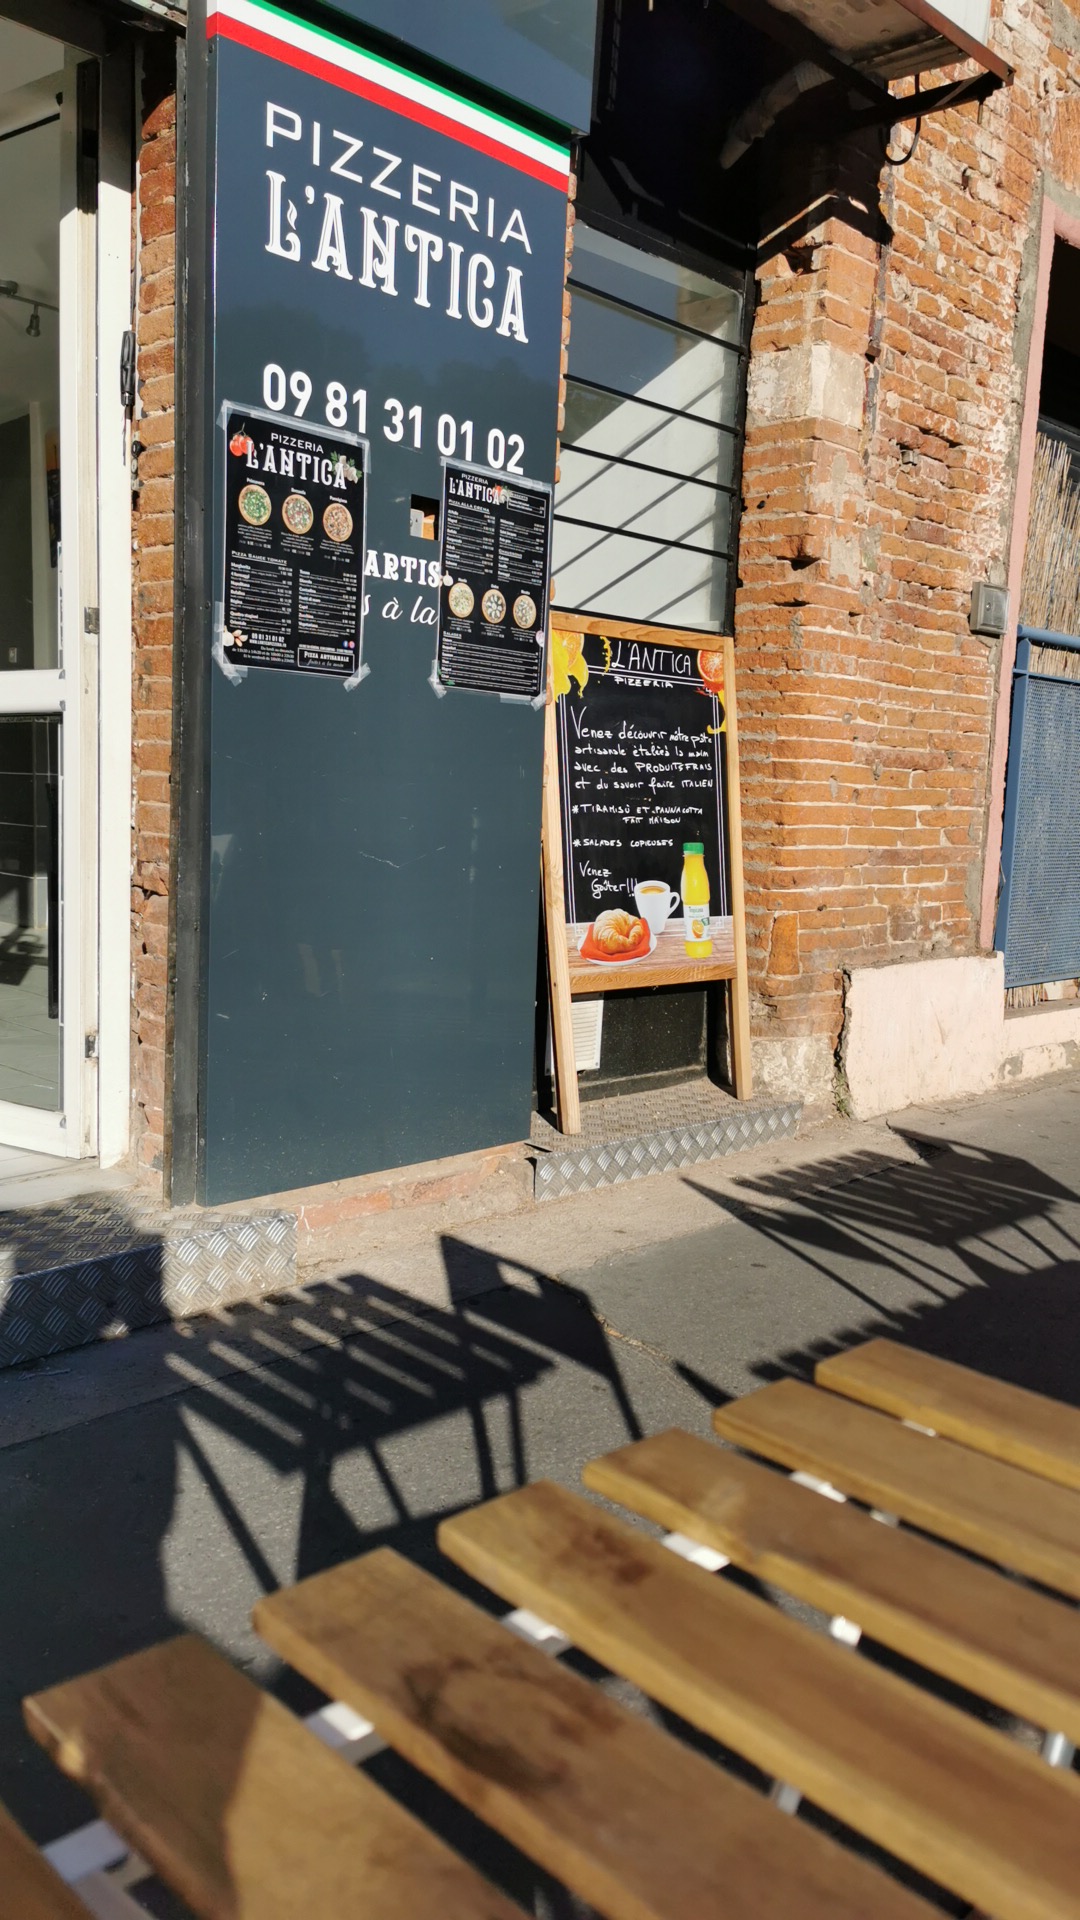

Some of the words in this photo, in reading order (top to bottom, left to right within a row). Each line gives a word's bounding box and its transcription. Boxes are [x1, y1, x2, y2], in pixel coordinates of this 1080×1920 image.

[266, 101, 532, 254] PIZZERIA
[265, 170, 529, 343] L'ANTICA
[263, 364, 312, 416] 09
[325, 382, 367, 433] 81
[383, 398, 422, 448] 31
[438, 414, 473, 461] 01
[487, 429, 525, 475] 02
[270, 432, 324, 454] PIZZERIA
[246, 440, 347, 490] L'ANTICA
[461, 473, 488, 485] PIZZERIA
[449, 477, 500, 505] L'ANTICA
[382, 597, 403, 620] à
[410, 596, 439, 625] la
[611, 641, 691, 676] L'ANTICA
[614, 676, 673, 688] PIZZERIA
[571, 705, 613, 739] Venez
[618, 720, 667, 739] découvrir
[575, 743, 626, 756] artisanale
[675, 746, 683, 756] la
[574, 762, 601, 772] avec
[611, 762, 628, 773] des
[575, 777, 591, 789] et
[596, 778, 609, 790] du
[648, 777, 675, 795] faire
[682, 779, 713, 788] ITALIEN
[623, 816, 643, 824] FAIT
[583, 839, 622, 847] SALADES
[579, 860, 612, 877] Venez
